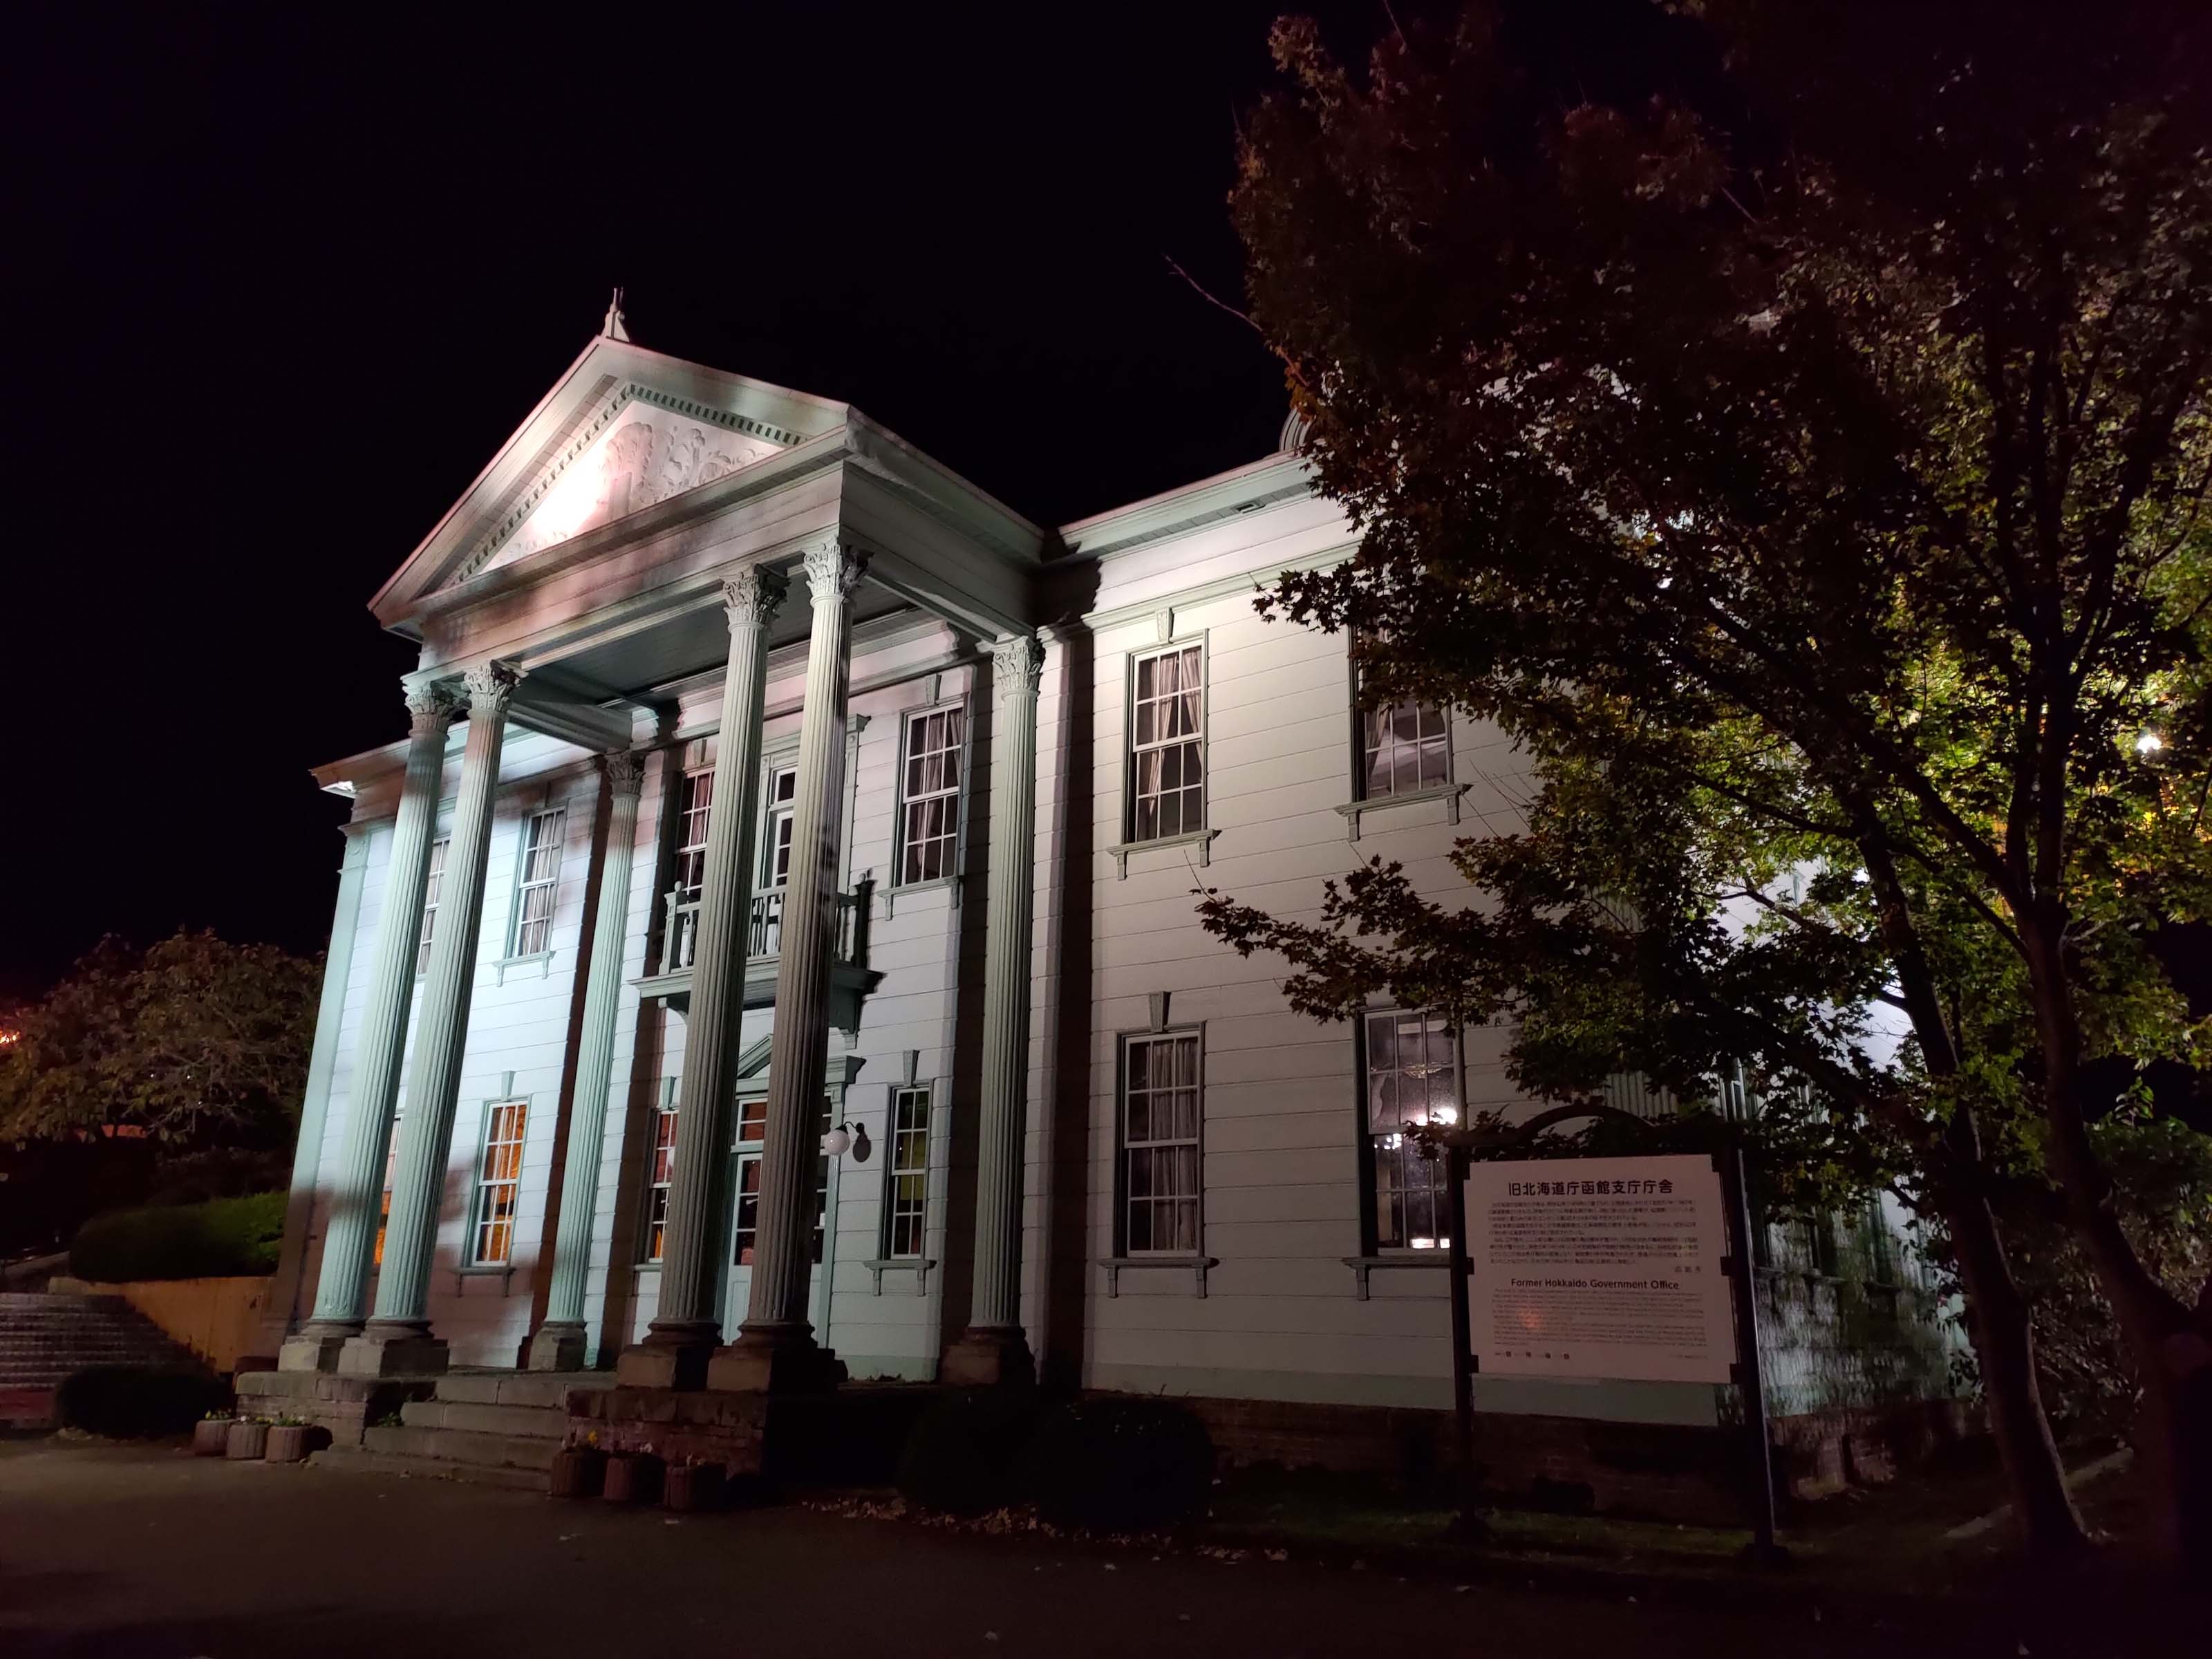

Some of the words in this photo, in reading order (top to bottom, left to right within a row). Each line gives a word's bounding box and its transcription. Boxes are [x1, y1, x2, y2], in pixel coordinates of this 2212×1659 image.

[1508, 1179, 1674, 1197] 旧北海道庁函館支庁庁舎
[1511, 1278, 1543, 1288] Former
[1545, 1278, 1587, 1288] Hokkaido
[1590, 1279, 1647, 1289] Government
[1651, 1280, 1679, 1290] Office
